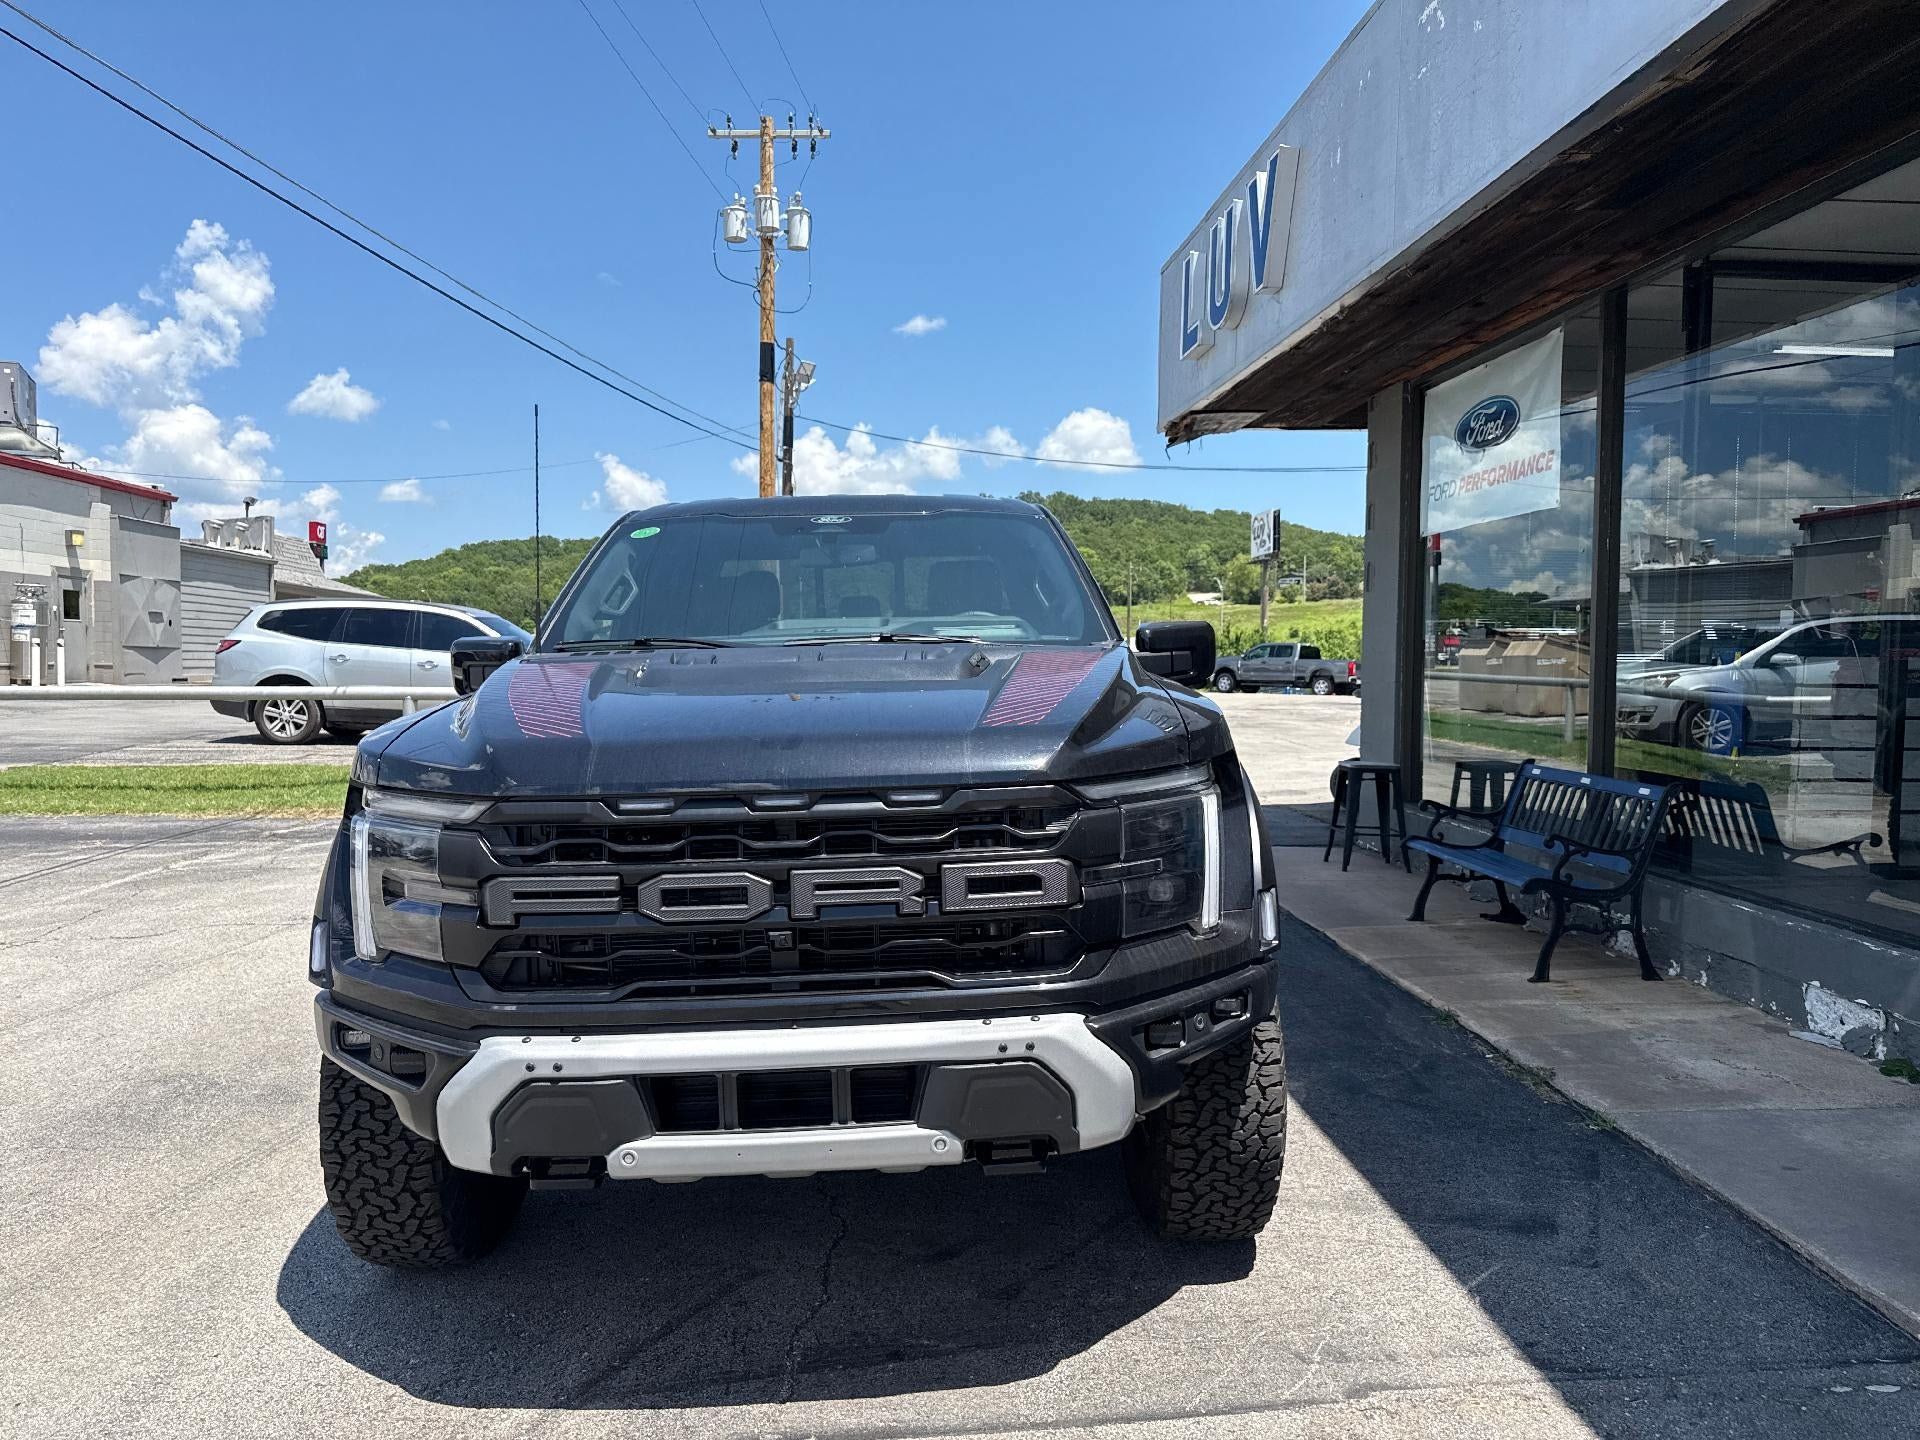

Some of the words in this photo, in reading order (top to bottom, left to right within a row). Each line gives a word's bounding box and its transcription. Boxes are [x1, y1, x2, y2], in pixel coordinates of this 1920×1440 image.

[1180, 145, 1297, 360] LUV
[1465, 405, 1507, 447] Ford
[1428, 480, 1457, 505] FORD
[1458, 449, 1554, 497] PERFORMANCE
[482, 861, 1081, 926] FORD
